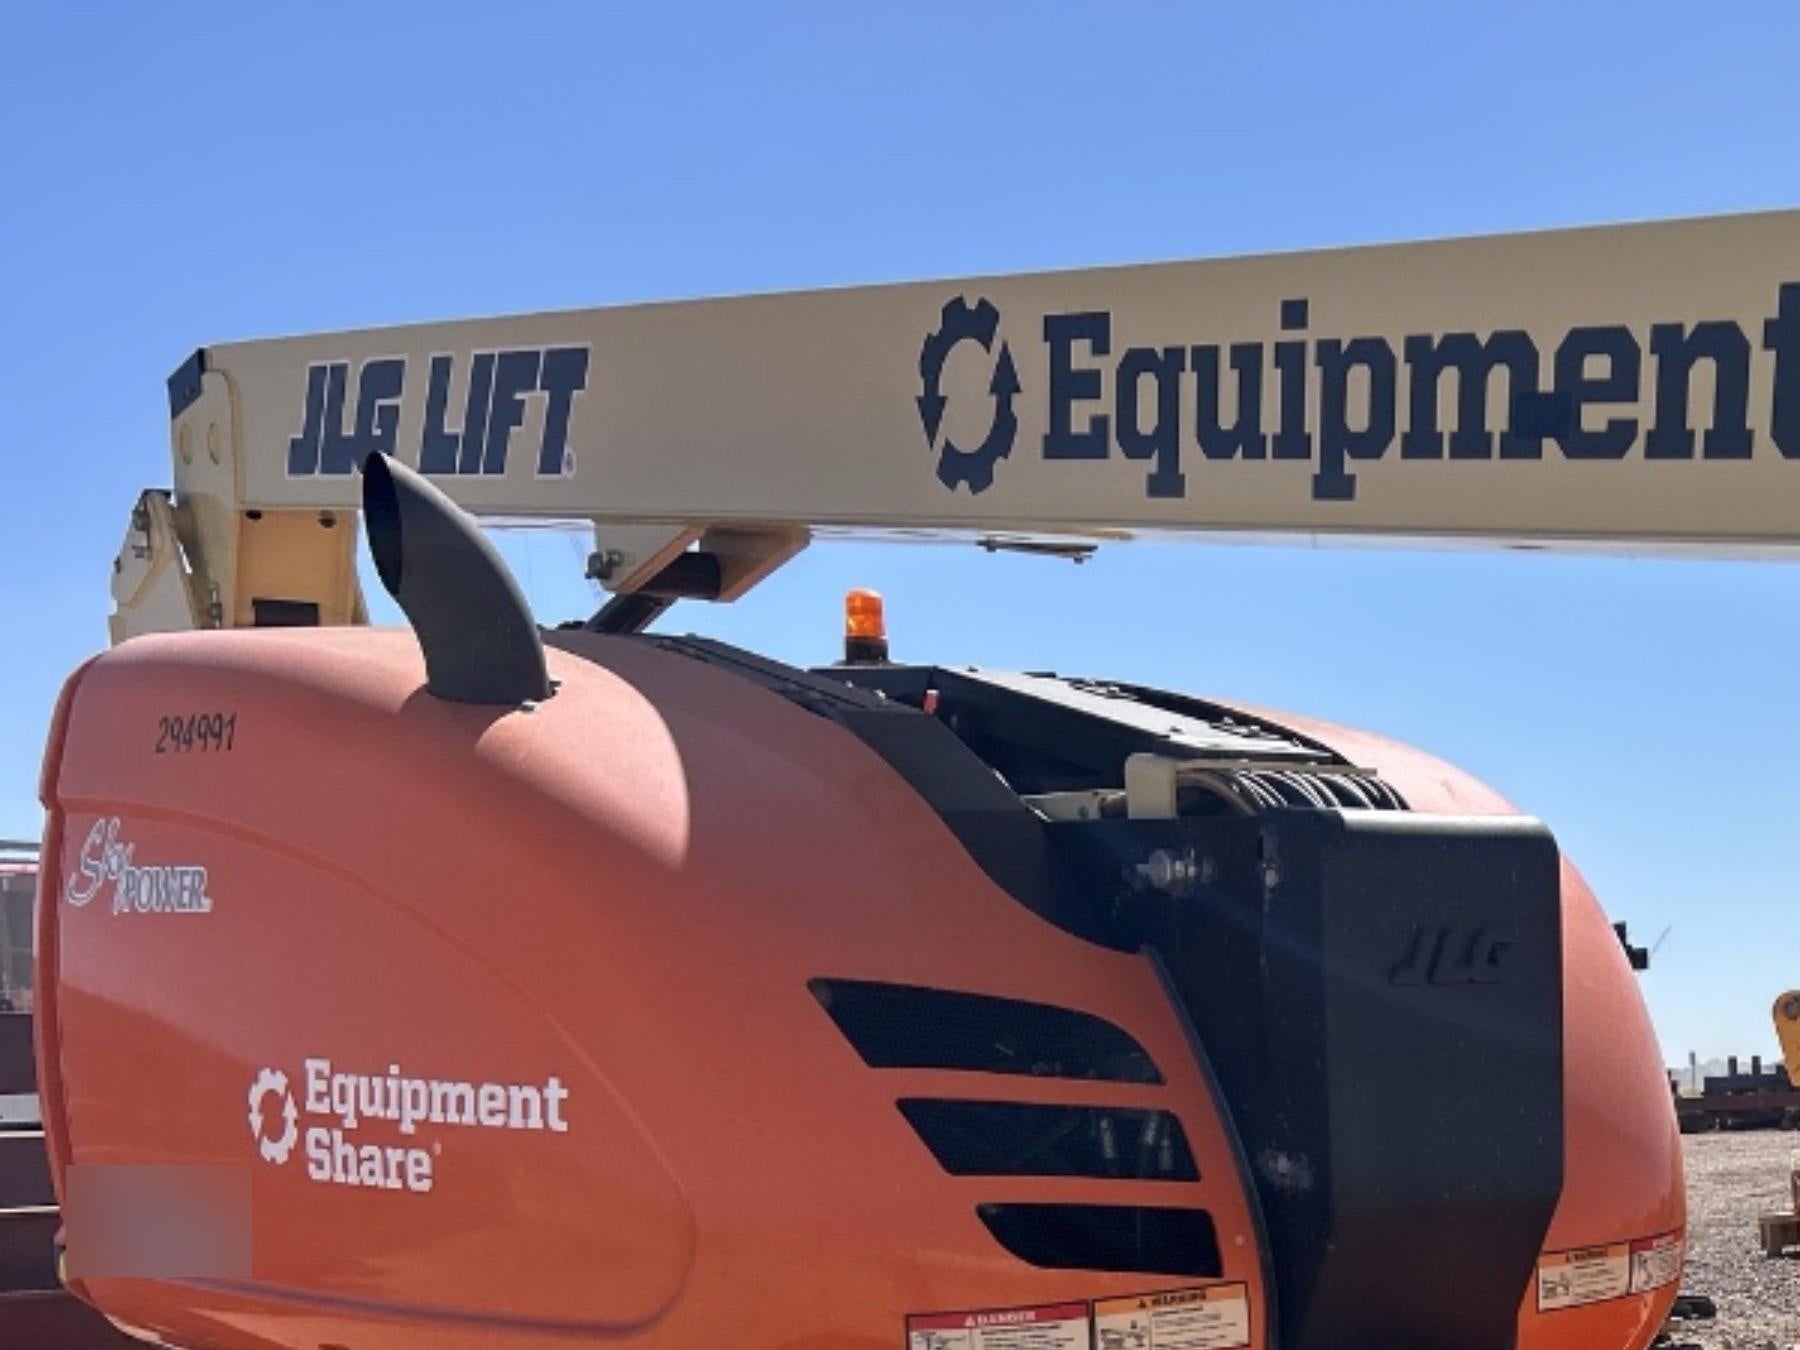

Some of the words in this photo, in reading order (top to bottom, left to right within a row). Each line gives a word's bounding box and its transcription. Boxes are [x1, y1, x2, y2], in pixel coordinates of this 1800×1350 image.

[287, 358, 406, 476] JLG
[419, 346, 590, 475] LIFT
[154, 712, 237, 754] 294991
[1390, 926, 1515, 987] JLG
[305, 1058, 569, 1134] Equipment
[305, 1127, 433, 1192] Share
